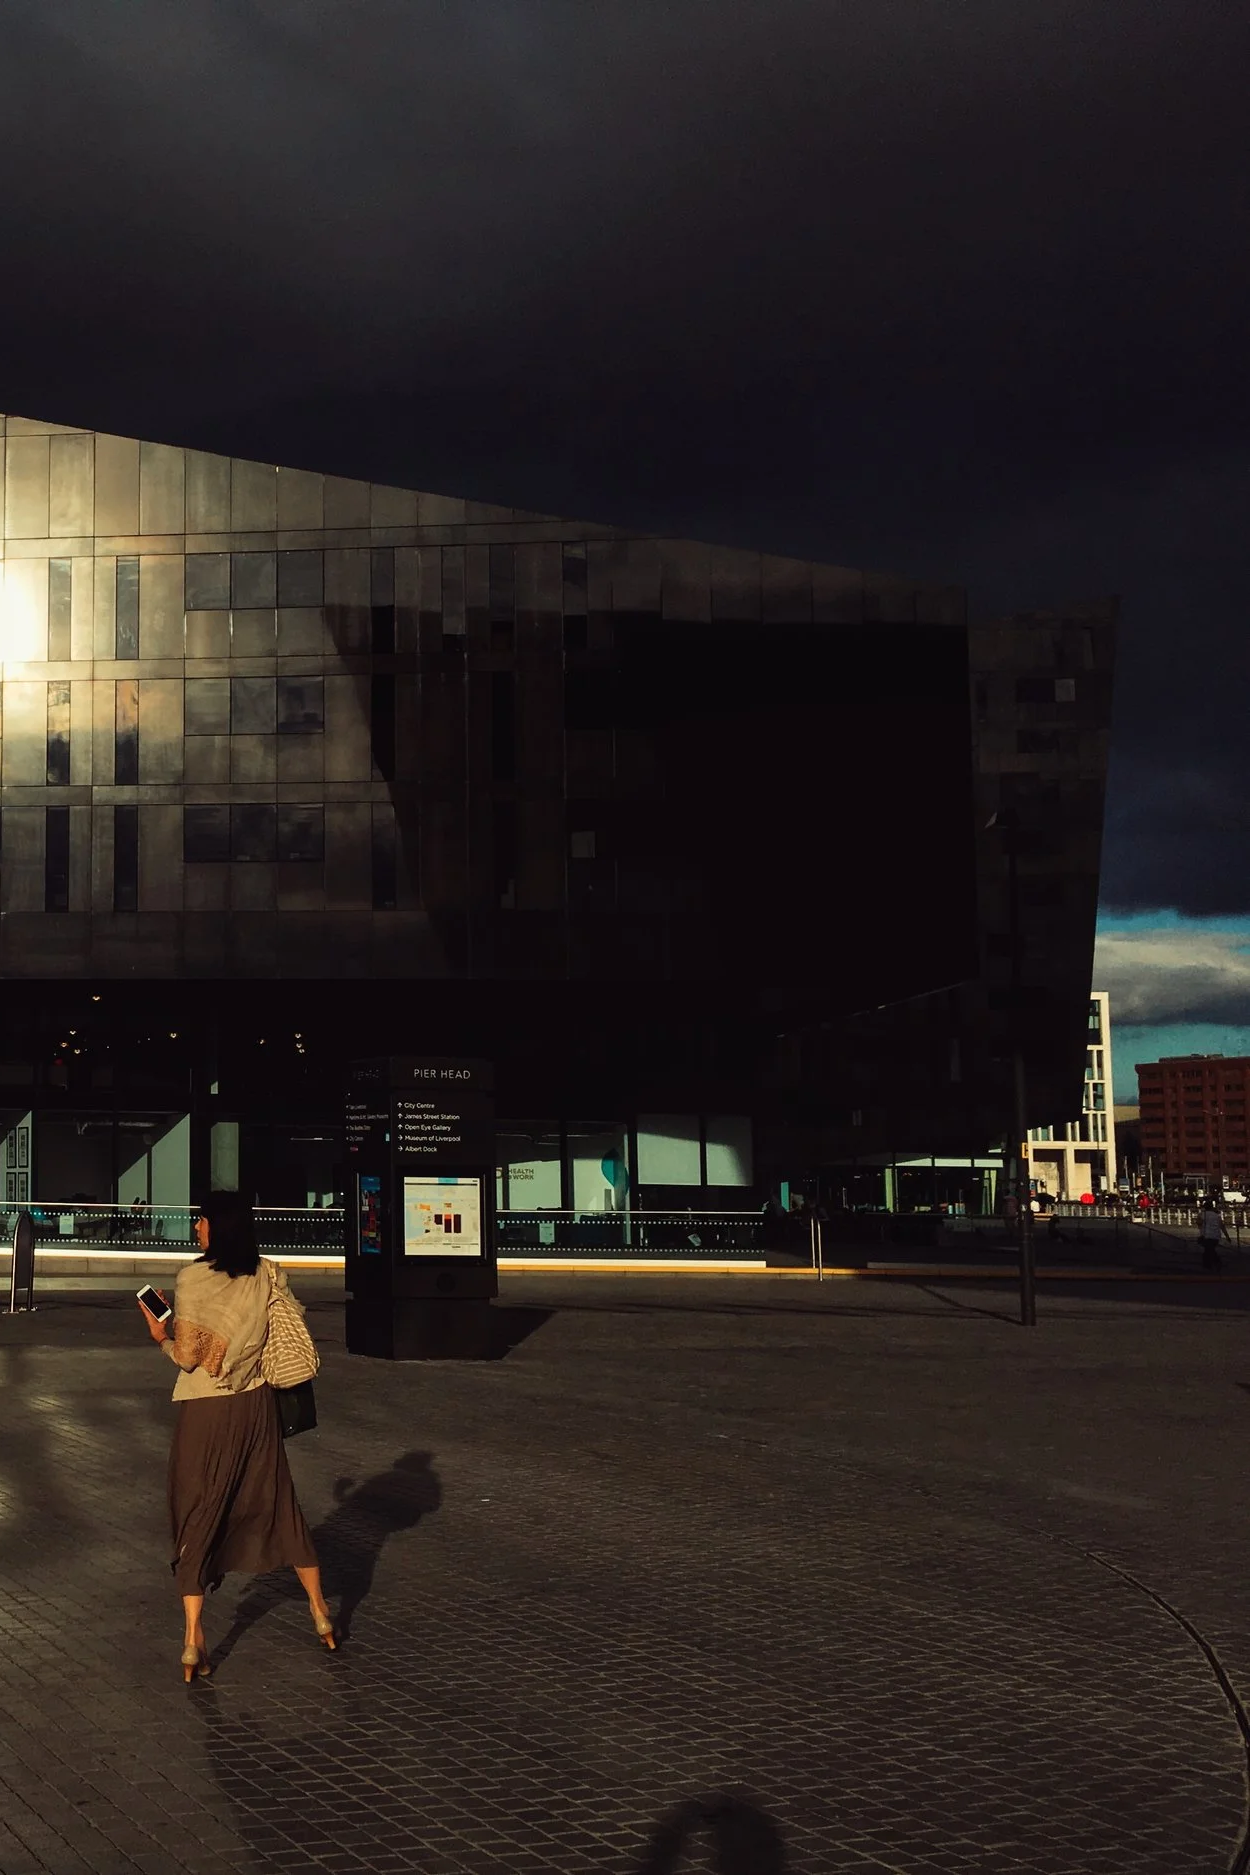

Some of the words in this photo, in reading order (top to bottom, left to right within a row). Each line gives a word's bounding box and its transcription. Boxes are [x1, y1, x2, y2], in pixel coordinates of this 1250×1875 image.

[414, 1068, 436, 1078] PIER
[440, 1069, 471, 1080] HEAD
[432, 1124, 451, 1132] Gallery
